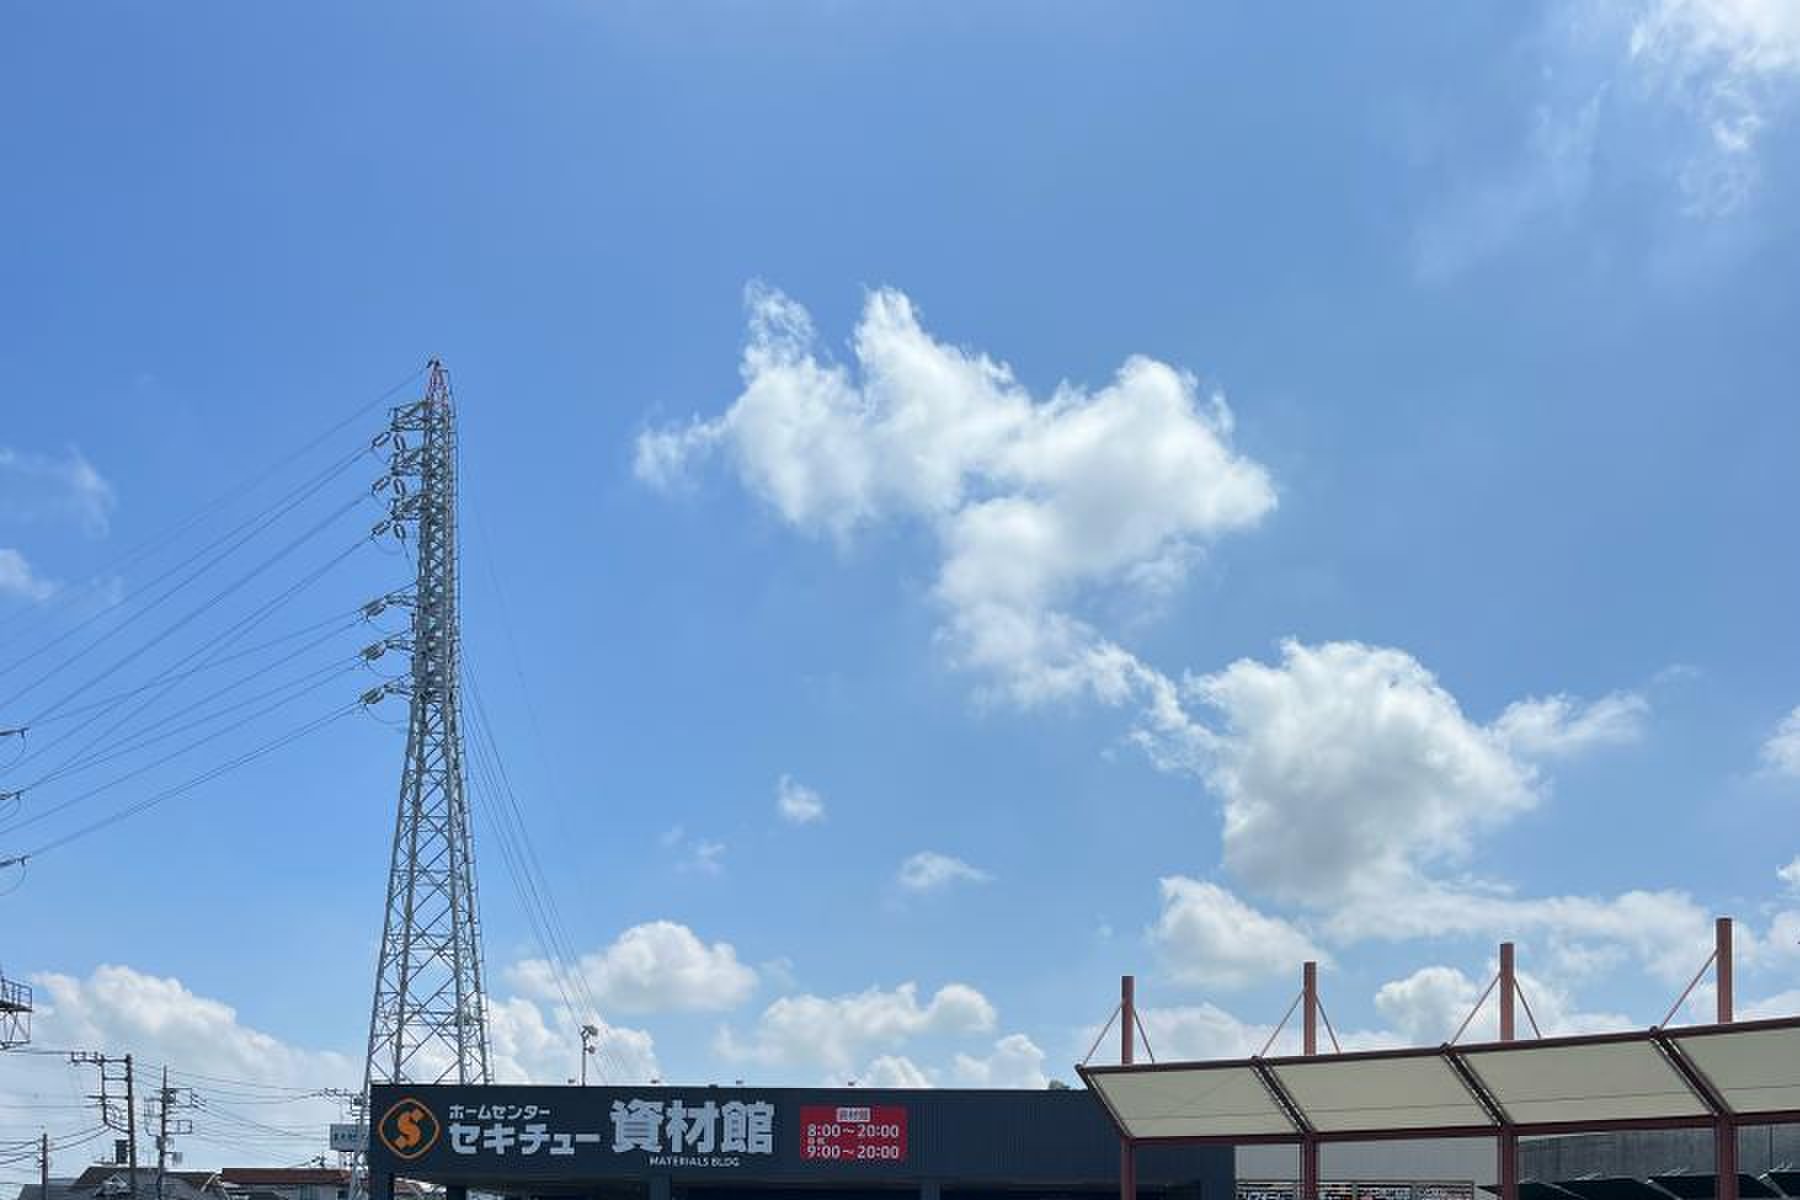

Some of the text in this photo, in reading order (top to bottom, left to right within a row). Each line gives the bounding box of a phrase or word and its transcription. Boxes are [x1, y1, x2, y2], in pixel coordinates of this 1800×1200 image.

[449, 1104, 551, 1120] ホームセンター
[609, 1099, 775, 1153] 資材館
[449, 1122, 600, 1155] セキチュー
[649, 1155, 709, 1168] MATERIALS
